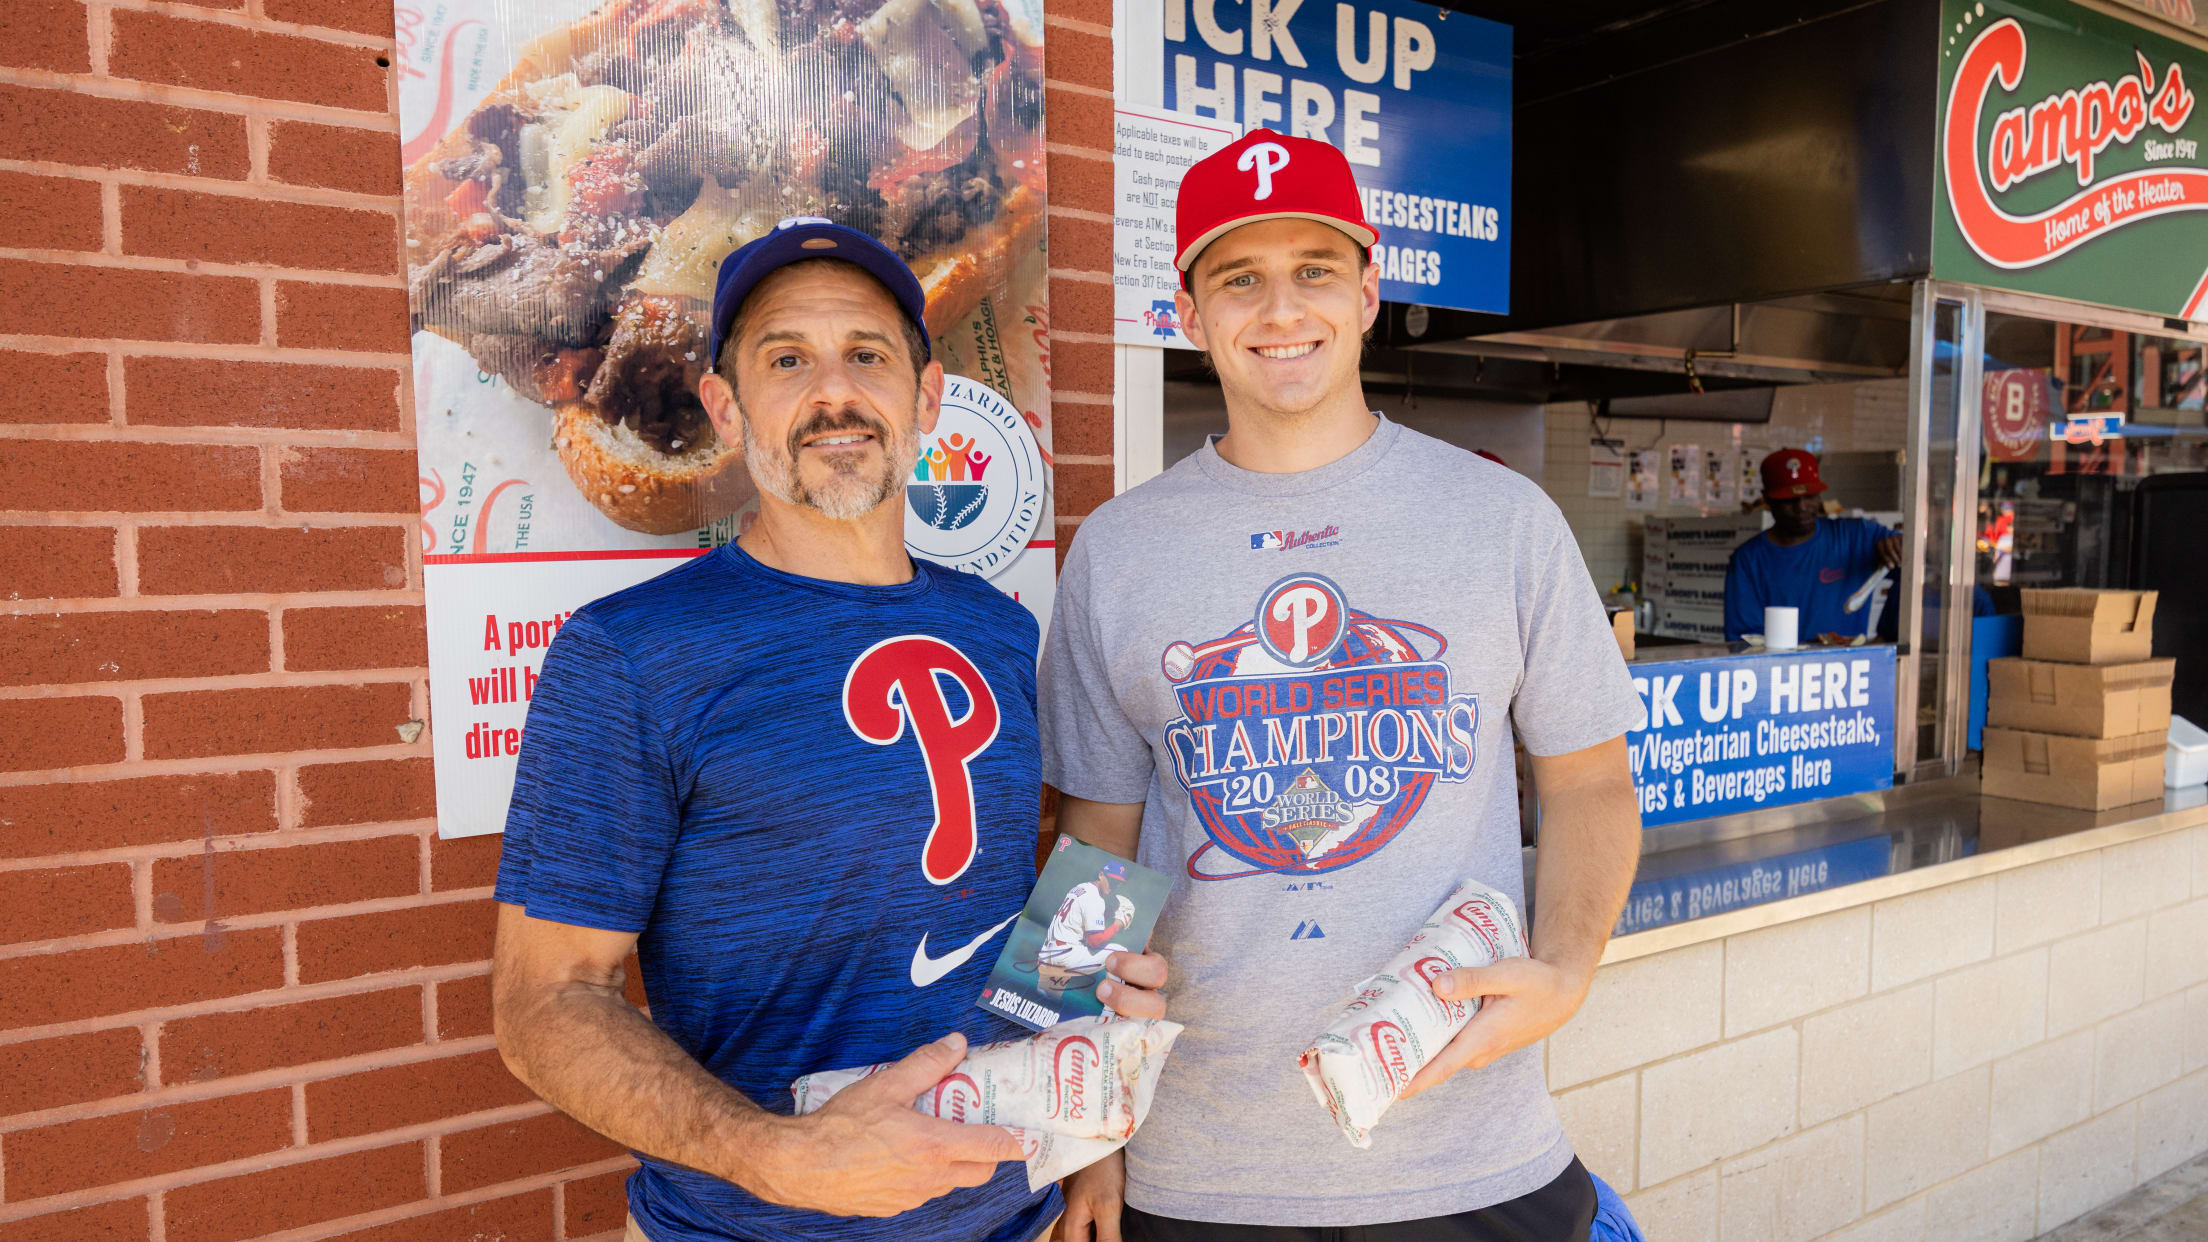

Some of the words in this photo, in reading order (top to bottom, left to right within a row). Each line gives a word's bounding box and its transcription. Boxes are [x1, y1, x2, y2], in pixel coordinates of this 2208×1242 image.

[1336, 2, 1437, 90] UP
[1175, 54, 1381, 167] HERE
[1116, 122, 1158, 142] Applicable
[1160, 132, 1181, 146] taxes
[1183, 135, 1197, 150] will
[1199, 137, 1208, 151] be
[1943, 17, 2195, 269] Campo's
[2144, 140, 2173, 161] Since
[2175, 138, 2198, 160] 1947
[1133, 147, 1143, 159] to
[1145, 149, 1164, 162] each
[1166, 153, 1193, 167] posted
[1237, 142, 1290, 200] P
[1132, 170, 1153, 185] Cash
[1126, 193, 1141, 204] are
[1143, 192, 1159, 206] NOT
[2045, 208, 2090, 251] Home
[2094, 198, 2112, 226] of
[2113, 188, 2134, 214] the
[2138, 179, 2185, 208] Heater
[1134, 238, 1143, 249] at
[1145, 236, 1175, 252] Section
[1145, 217, 1169, 233] ATM's
[1114, 252, 1131, 266] New
[1133, 254, 1147, 269] Era
[1150, 256, 1171, 271] Team
[1142, 275, 1155, 288] 317
[2006, 383, 2025, 421] B
[458, 461, 477, 506] 1947
[520, 494, 534, 520] USA
[516, 522, 530, 549] THE
[1280, 524, 1340, 552] Authentic
[484, 615, 501, 651] A
[508, 611, 571, 656] port
[1272, 586, 1328, 664] P
[469, 667, 517, 706] will
[1181, 681, 1313, 722] WORLD
[1322, 669, 1447, 709] SERIES
[1699, 669, 1758, 723] UP
[1770, 659, 1871, 715] HERE
[465, 722, 525, 760] dire
[1167, 702, 1477, 787] CHAMPIONS
[1756, 710, 1881, 756] Cheesesteaks,
[842, 634, 1001, 886] P
[1230, 771, 1275, 806] 20
[1344, 765, 1391, 798] 08
[1276, 790, 1340, 807] WORLD
[1674, 778, 1686, 809] &
[1692, 764, 1786, 803] Beverages
[1791, 754, 1832, 789] Here
[1262, 802, 1355, 829] SERIES
[1047, 1034, 1100, 1120] Campo's
